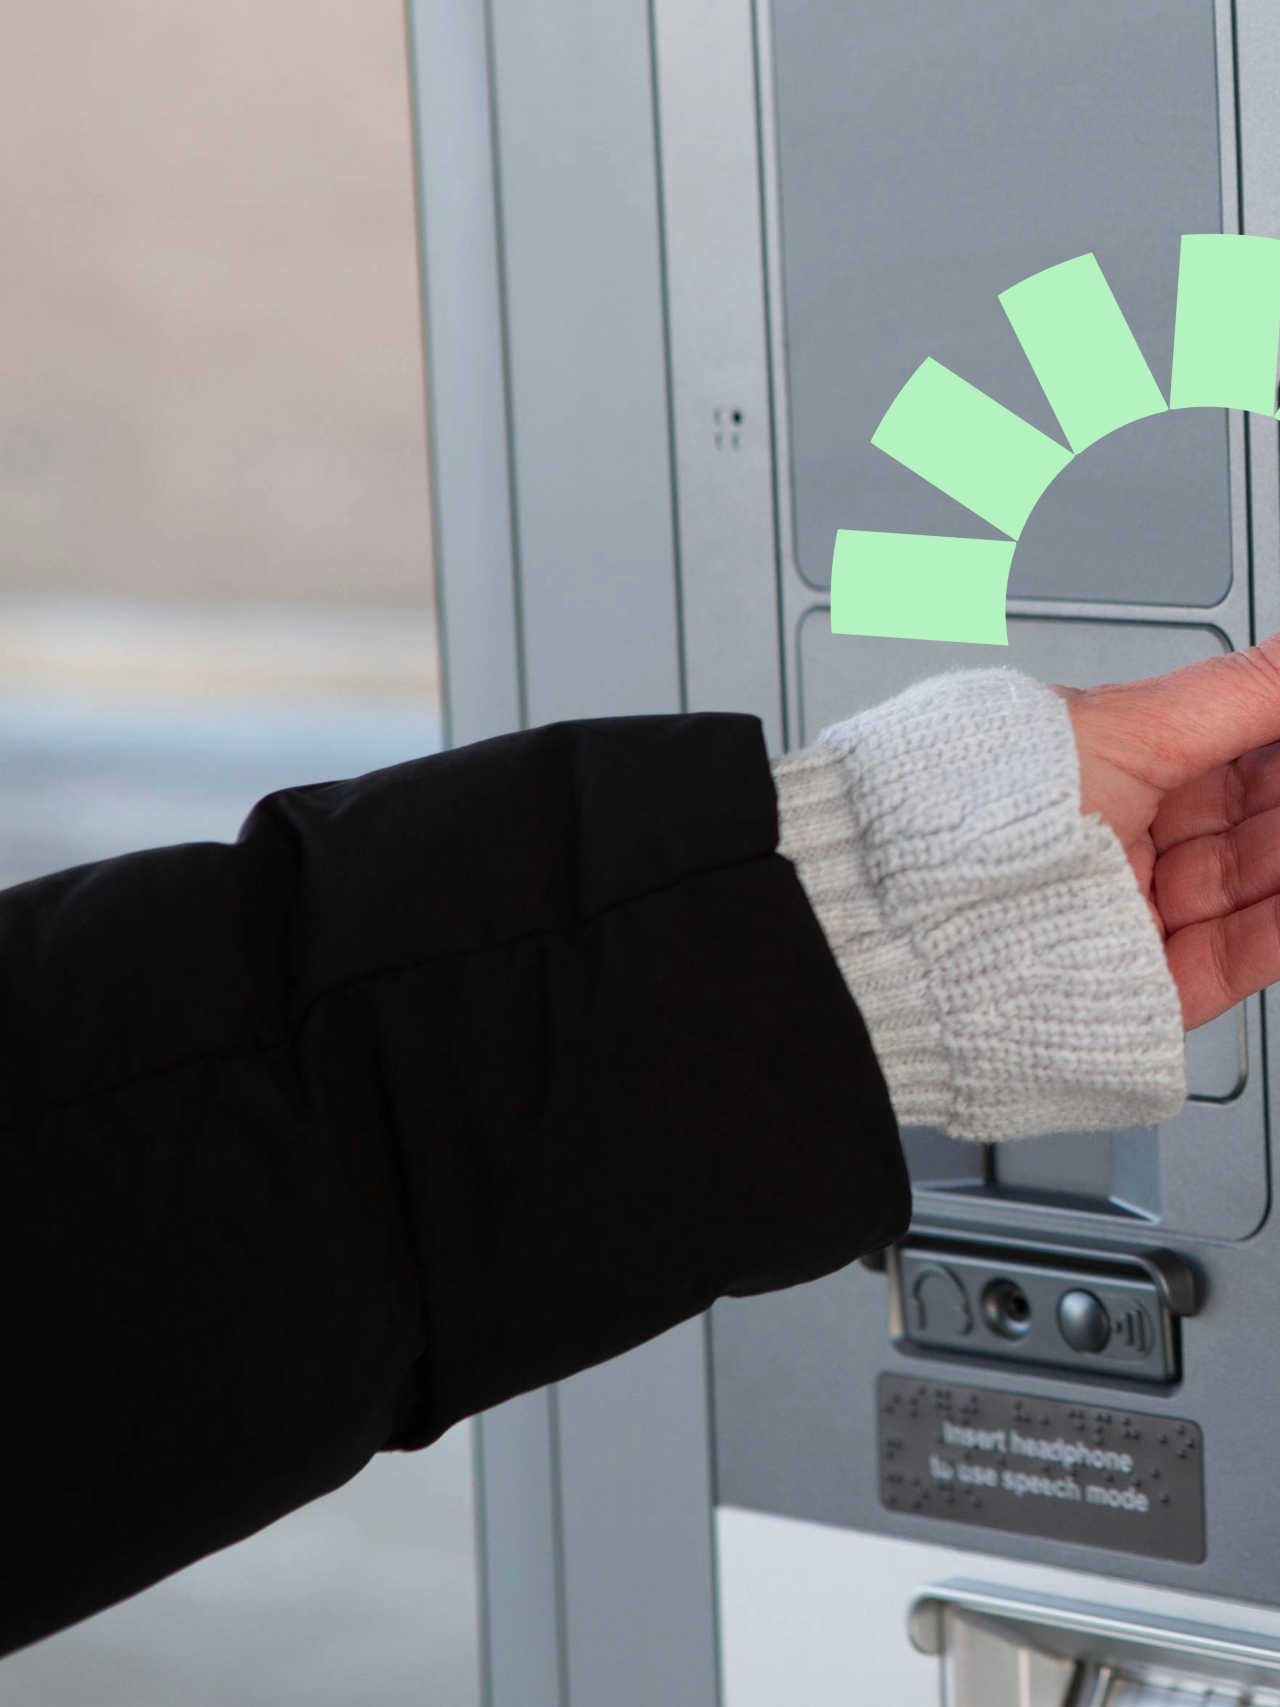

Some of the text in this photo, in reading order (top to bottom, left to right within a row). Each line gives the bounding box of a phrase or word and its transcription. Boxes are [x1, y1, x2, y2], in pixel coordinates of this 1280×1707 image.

[942, 1421, 1134, 1473] Insert headphone
[956, 1462, 998, 1488] use
[1001, 1470, 1081, 1501] speech
[1085, 1484, 1149, 1512] mode
